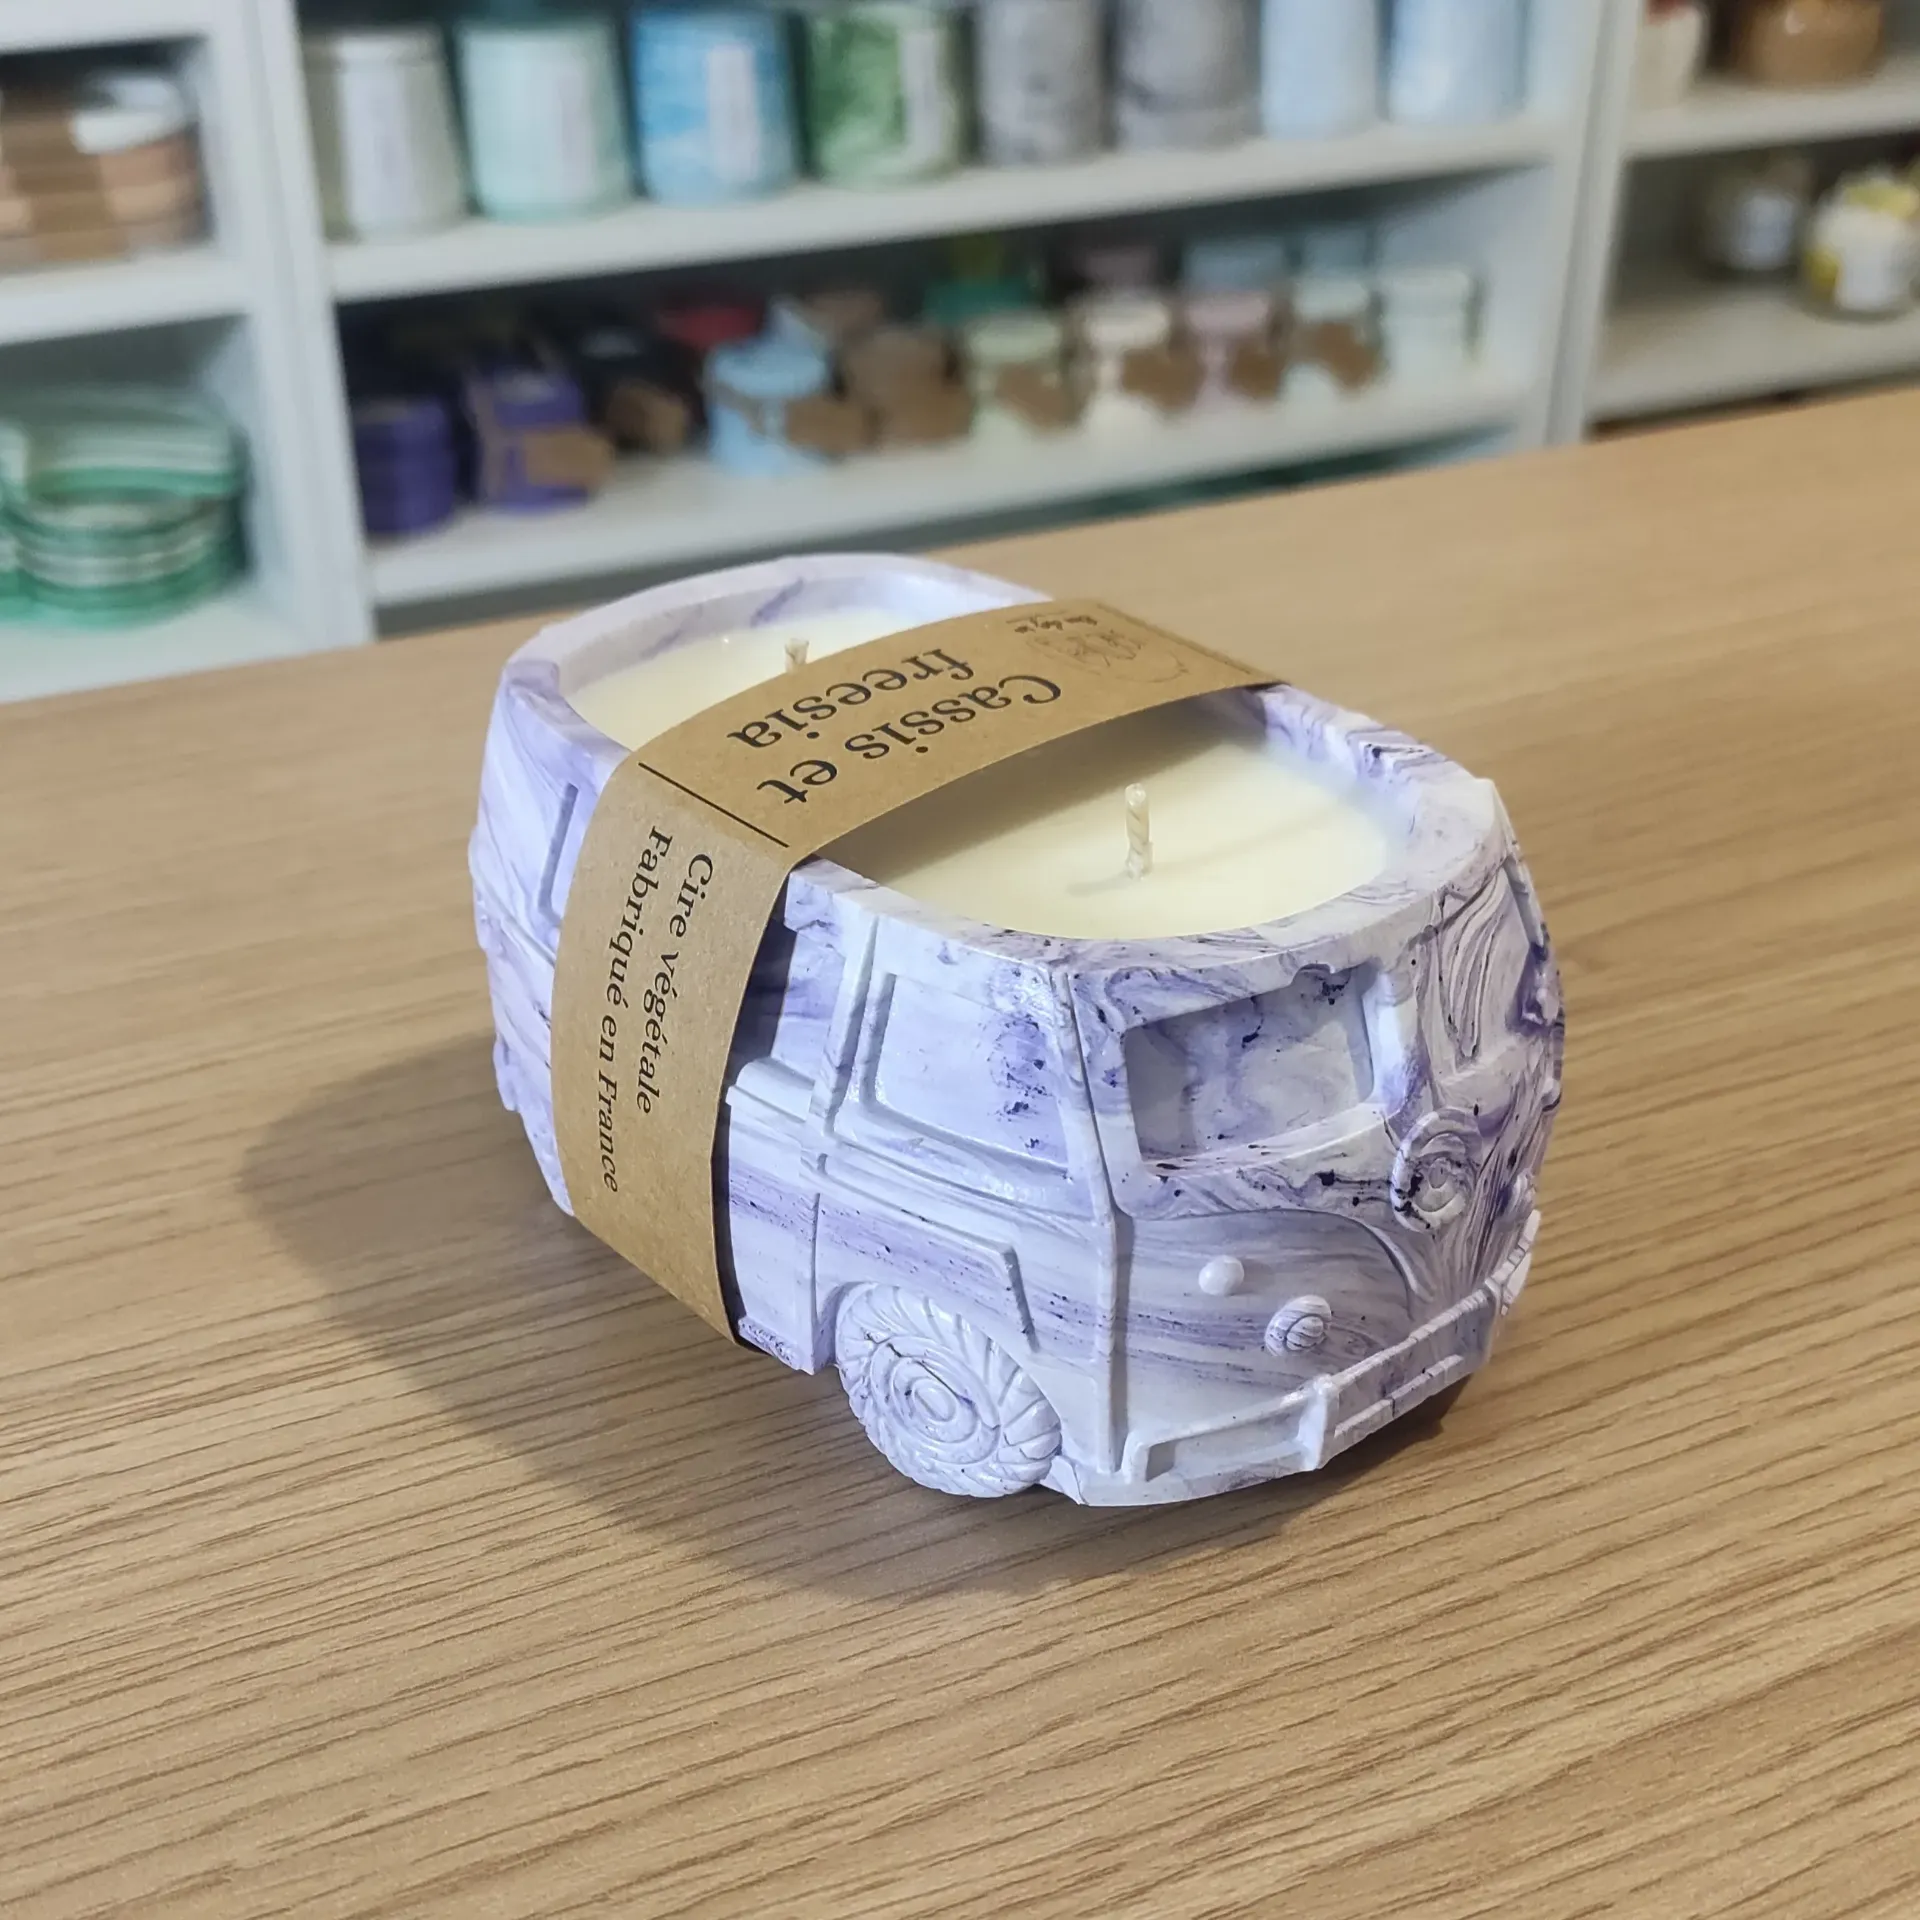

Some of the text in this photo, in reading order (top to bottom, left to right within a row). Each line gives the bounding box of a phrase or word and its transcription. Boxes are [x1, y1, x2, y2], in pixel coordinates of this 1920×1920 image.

[727, 649, 975, 749] freesia
[757, 675, 1062, 804] Cassis et
[599, 825, 674, 1193] Fabriqué en France
[636, 853, 714, 1115] Cire végétale
